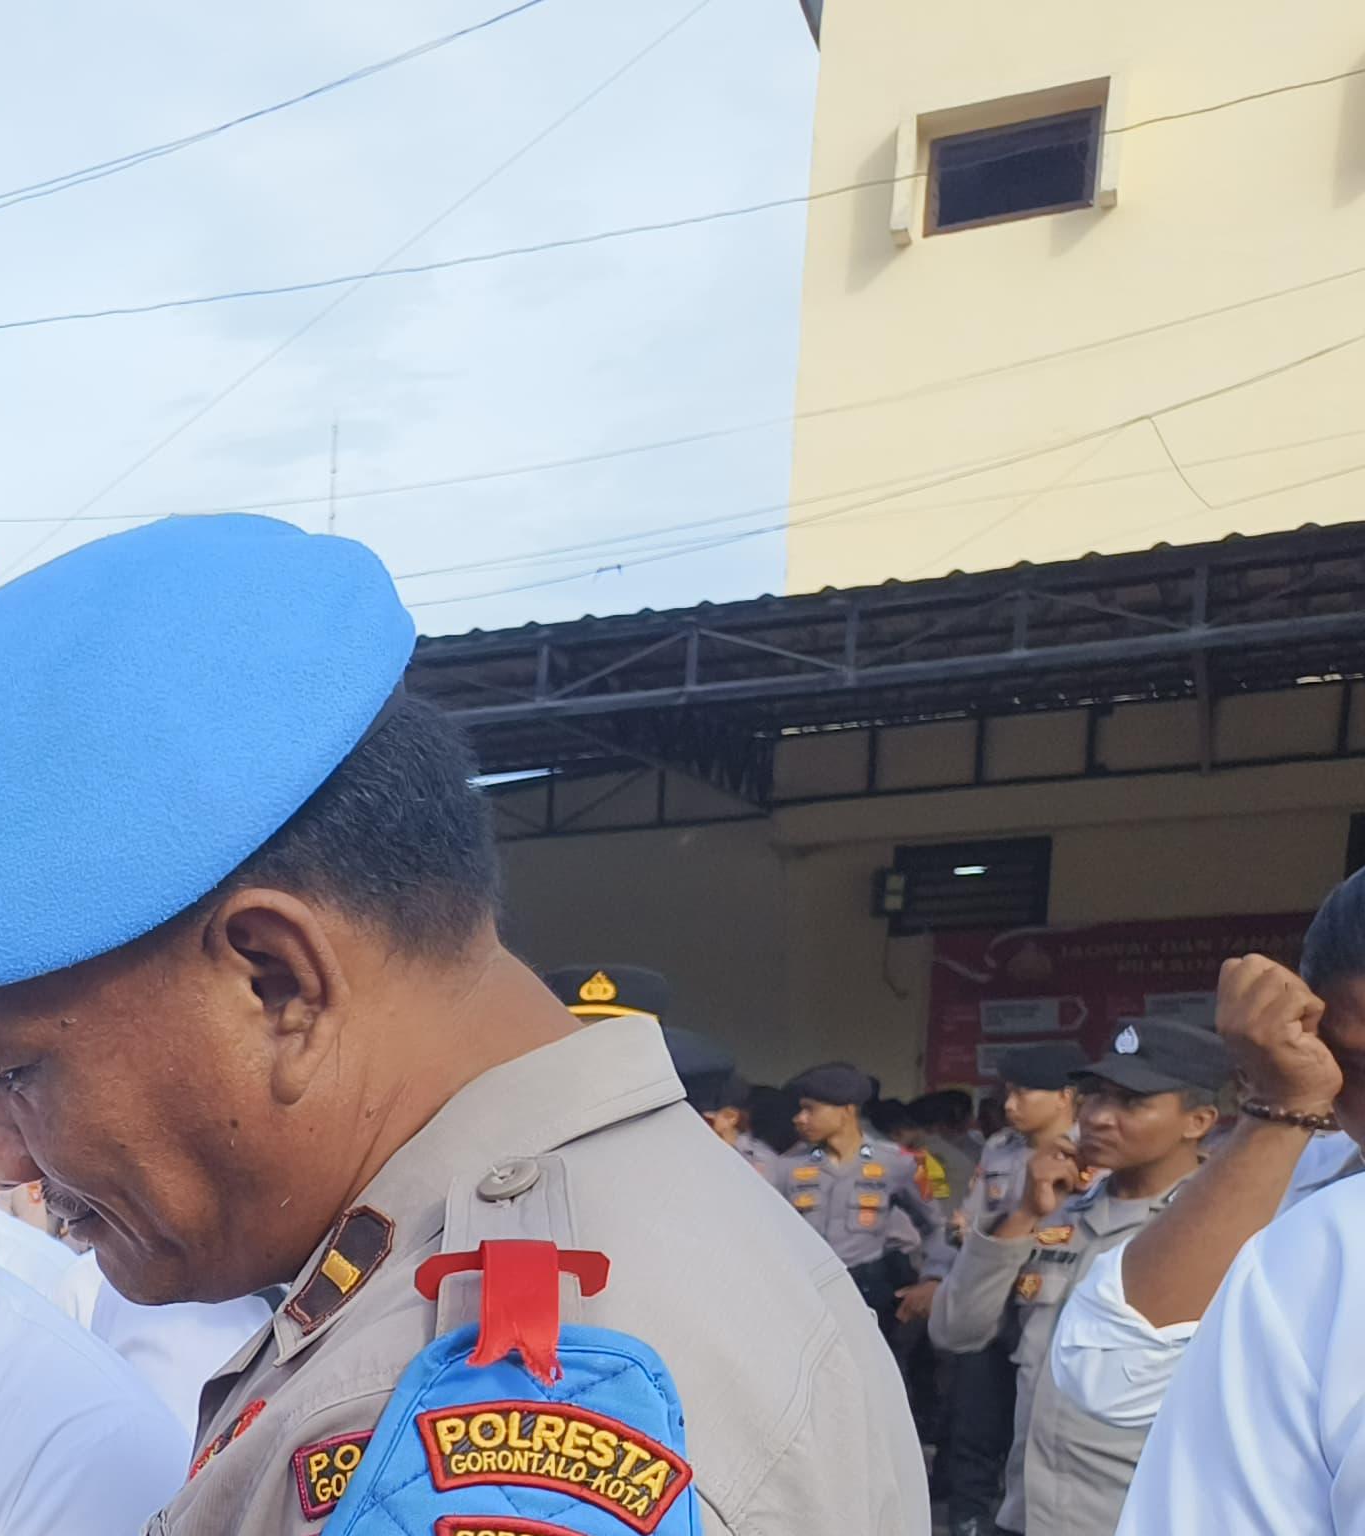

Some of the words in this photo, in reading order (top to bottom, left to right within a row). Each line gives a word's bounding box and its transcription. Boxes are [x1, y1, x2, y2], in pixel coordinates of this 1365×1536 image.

[316, 1471, 354, 1501] GO
[435, 1411, 671, 1500] POLRESTA
[450, 1450, 588, 1482] GORONTALO
[590, 1471, 650, 1517] KOTA
